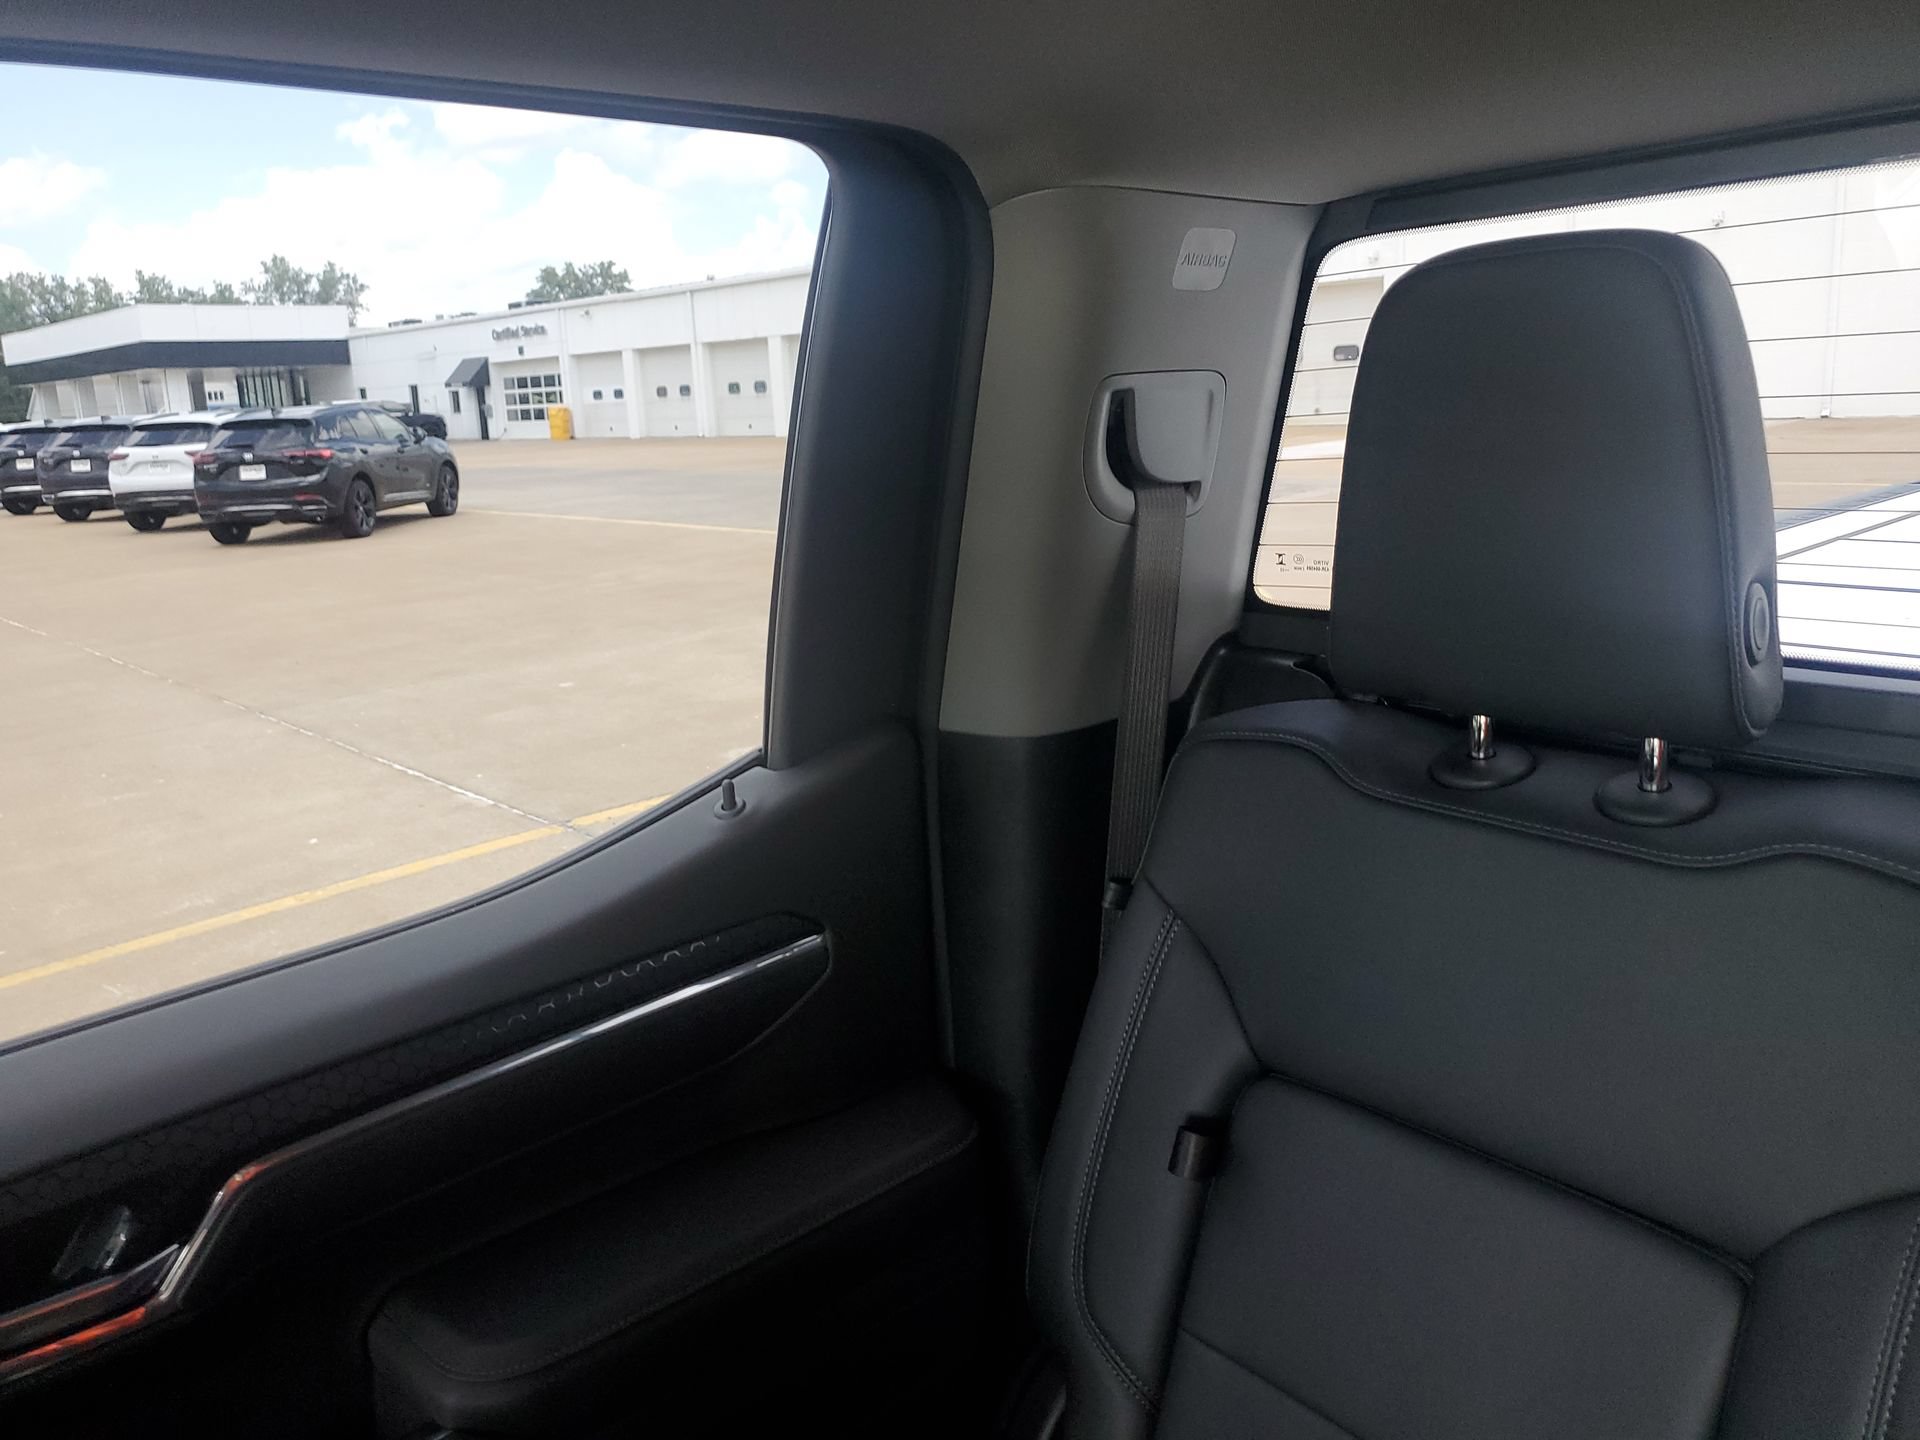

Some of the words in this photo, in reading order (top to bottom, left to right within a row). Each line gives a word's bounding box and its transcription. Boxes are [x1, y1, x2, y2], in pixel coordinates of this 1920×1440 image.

[1181, 252, 1228, 268] AIRBAG
[491, 326, 519, 341] Certified
[520, 323, 547, 337] Service
